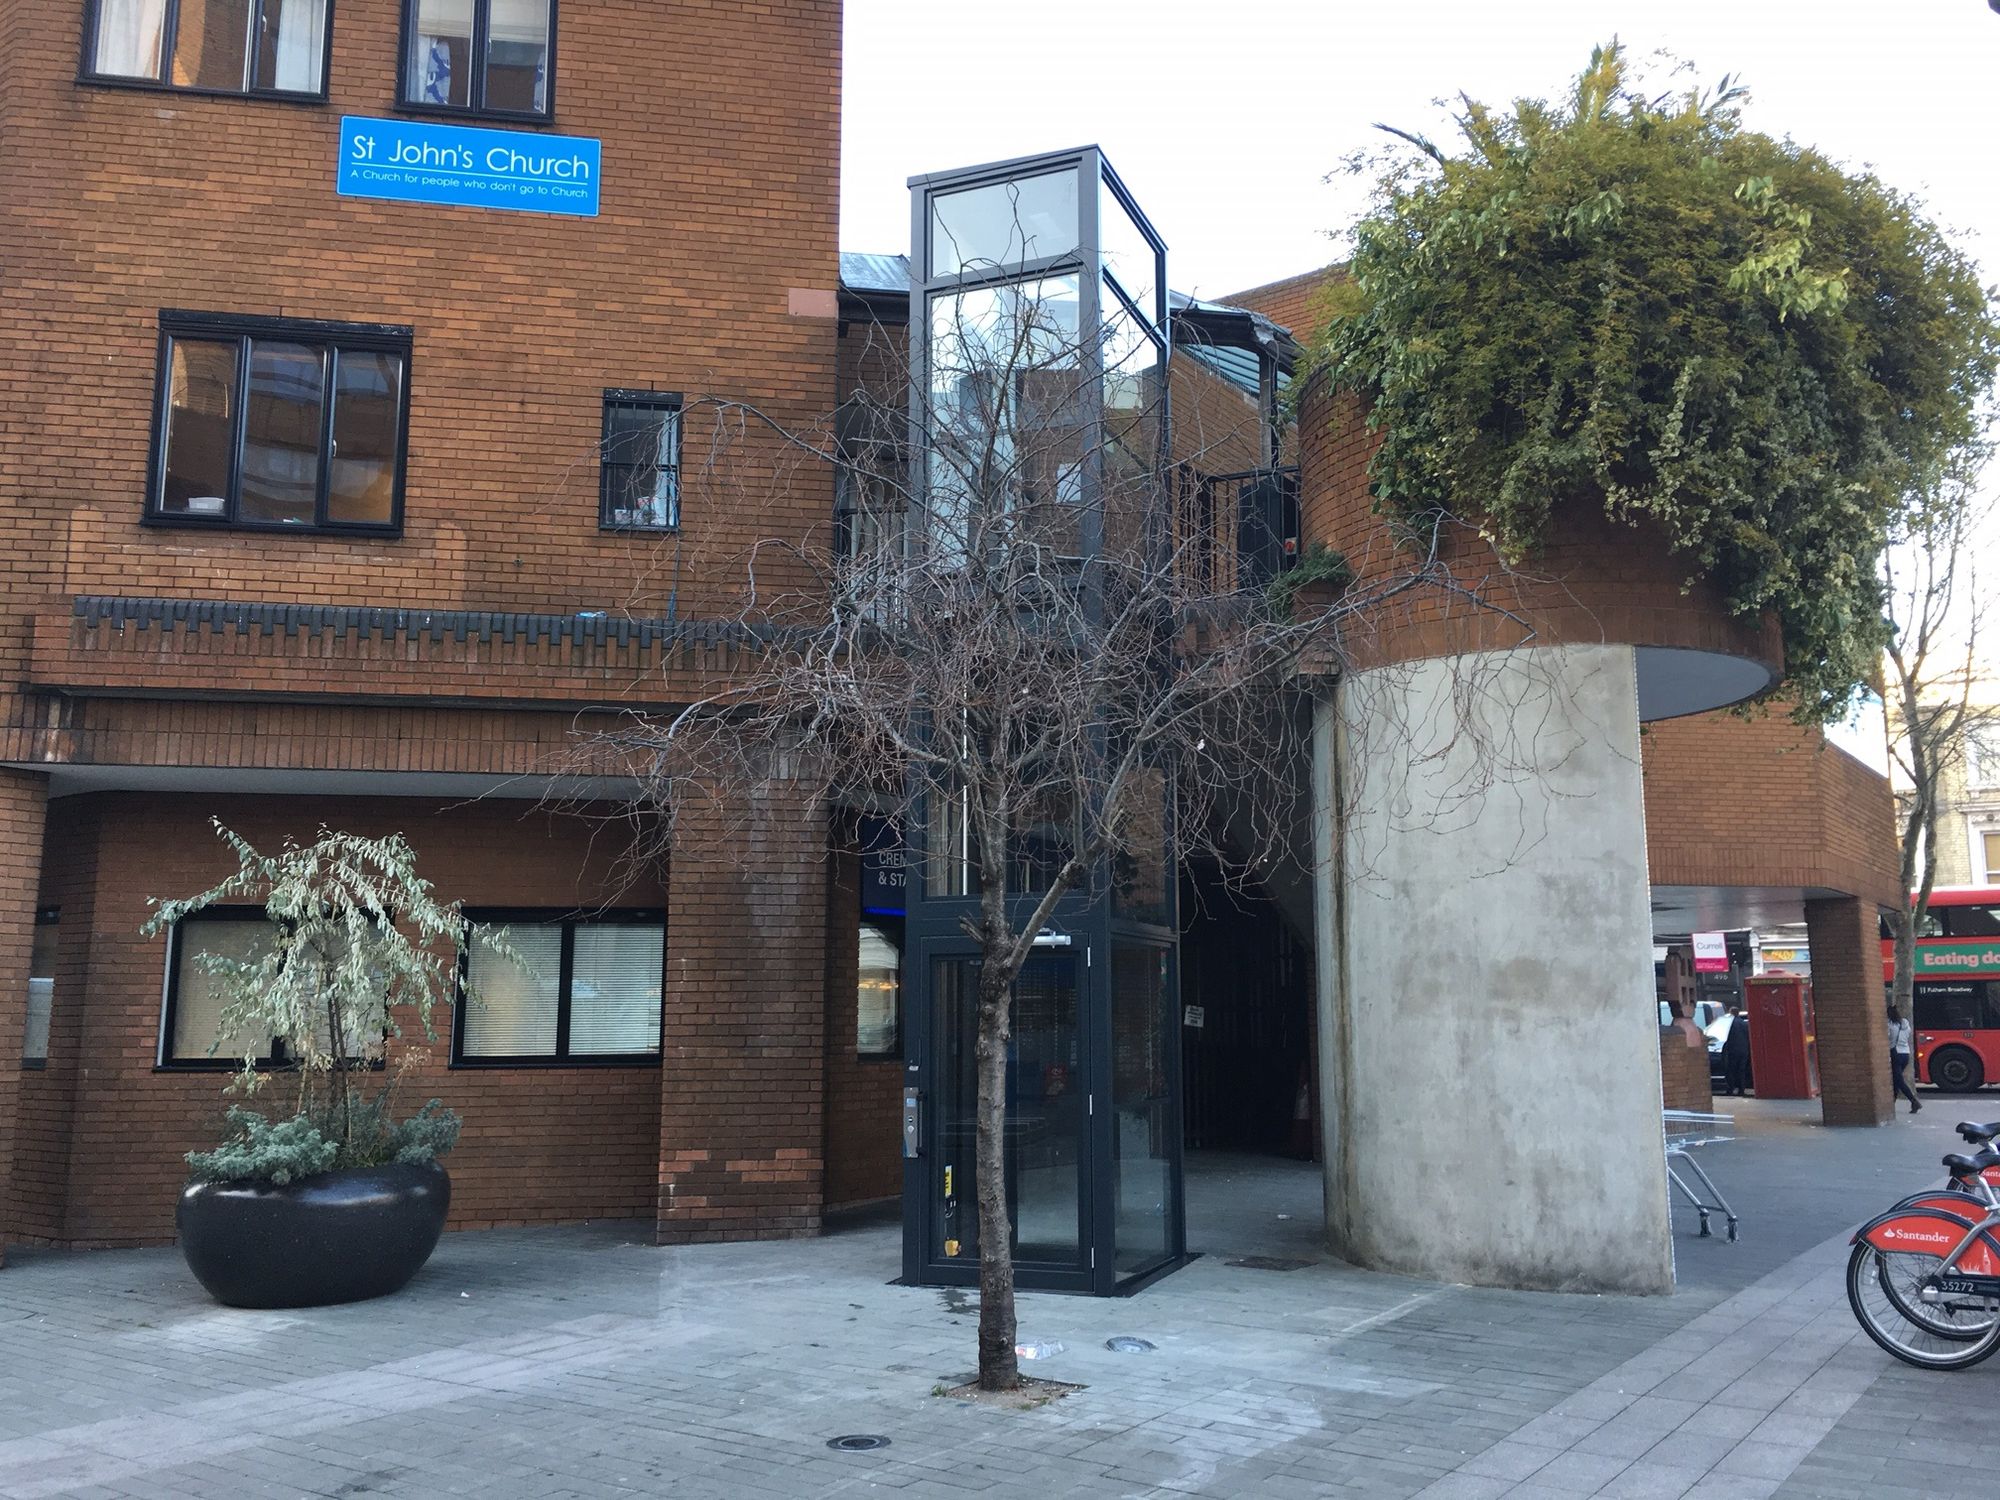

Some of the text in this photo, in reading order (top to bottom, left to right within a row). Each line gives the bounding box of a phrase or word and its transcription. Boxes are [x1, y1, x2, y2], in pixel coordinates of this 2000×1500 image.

[351, 135, 589, 179] St John's Church
[350, 169, 588, 198] A Church for people who don't go to Church
[878, 871, 887, 885] &
[1923, 952, 1979, 968] Eating
[1896, 1229, 1950, 1243] Santander
[1941, 1281, 1975, 1292] 35272
